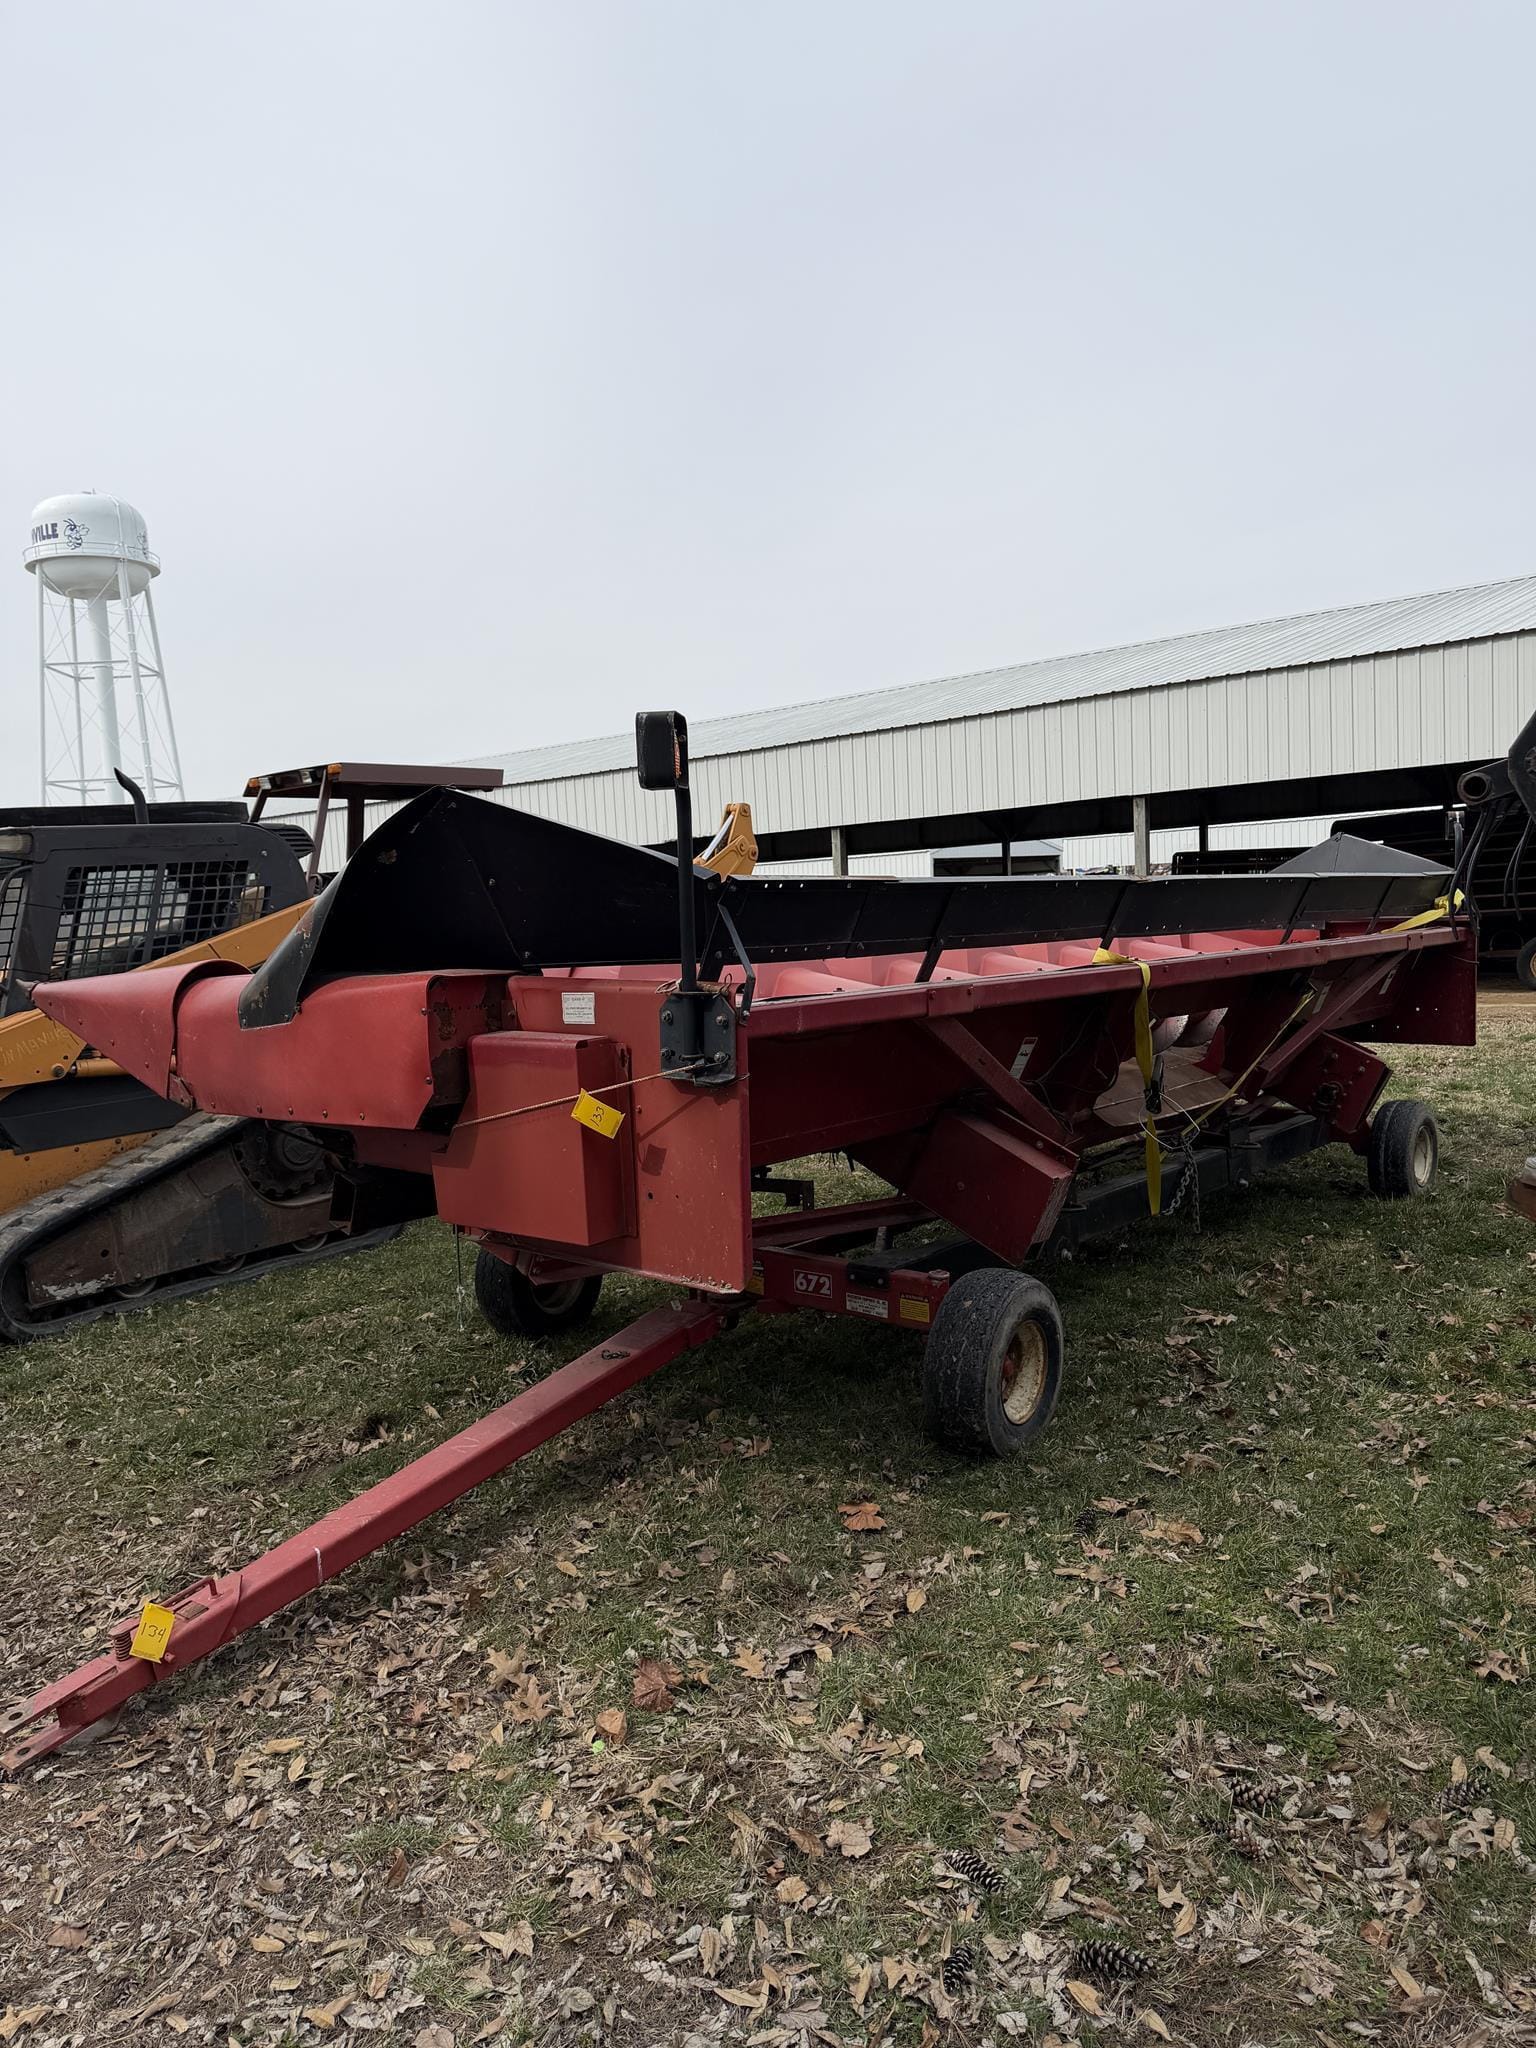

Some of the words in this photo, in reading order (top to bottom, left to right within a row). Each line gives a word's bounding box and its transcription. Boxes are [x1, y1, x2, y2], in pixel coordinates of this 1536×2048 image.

[590, 1105, 605, 1127] 133
[796, 1273, 831, 1295] 672
[141, 1622, 167, 1643] 134
